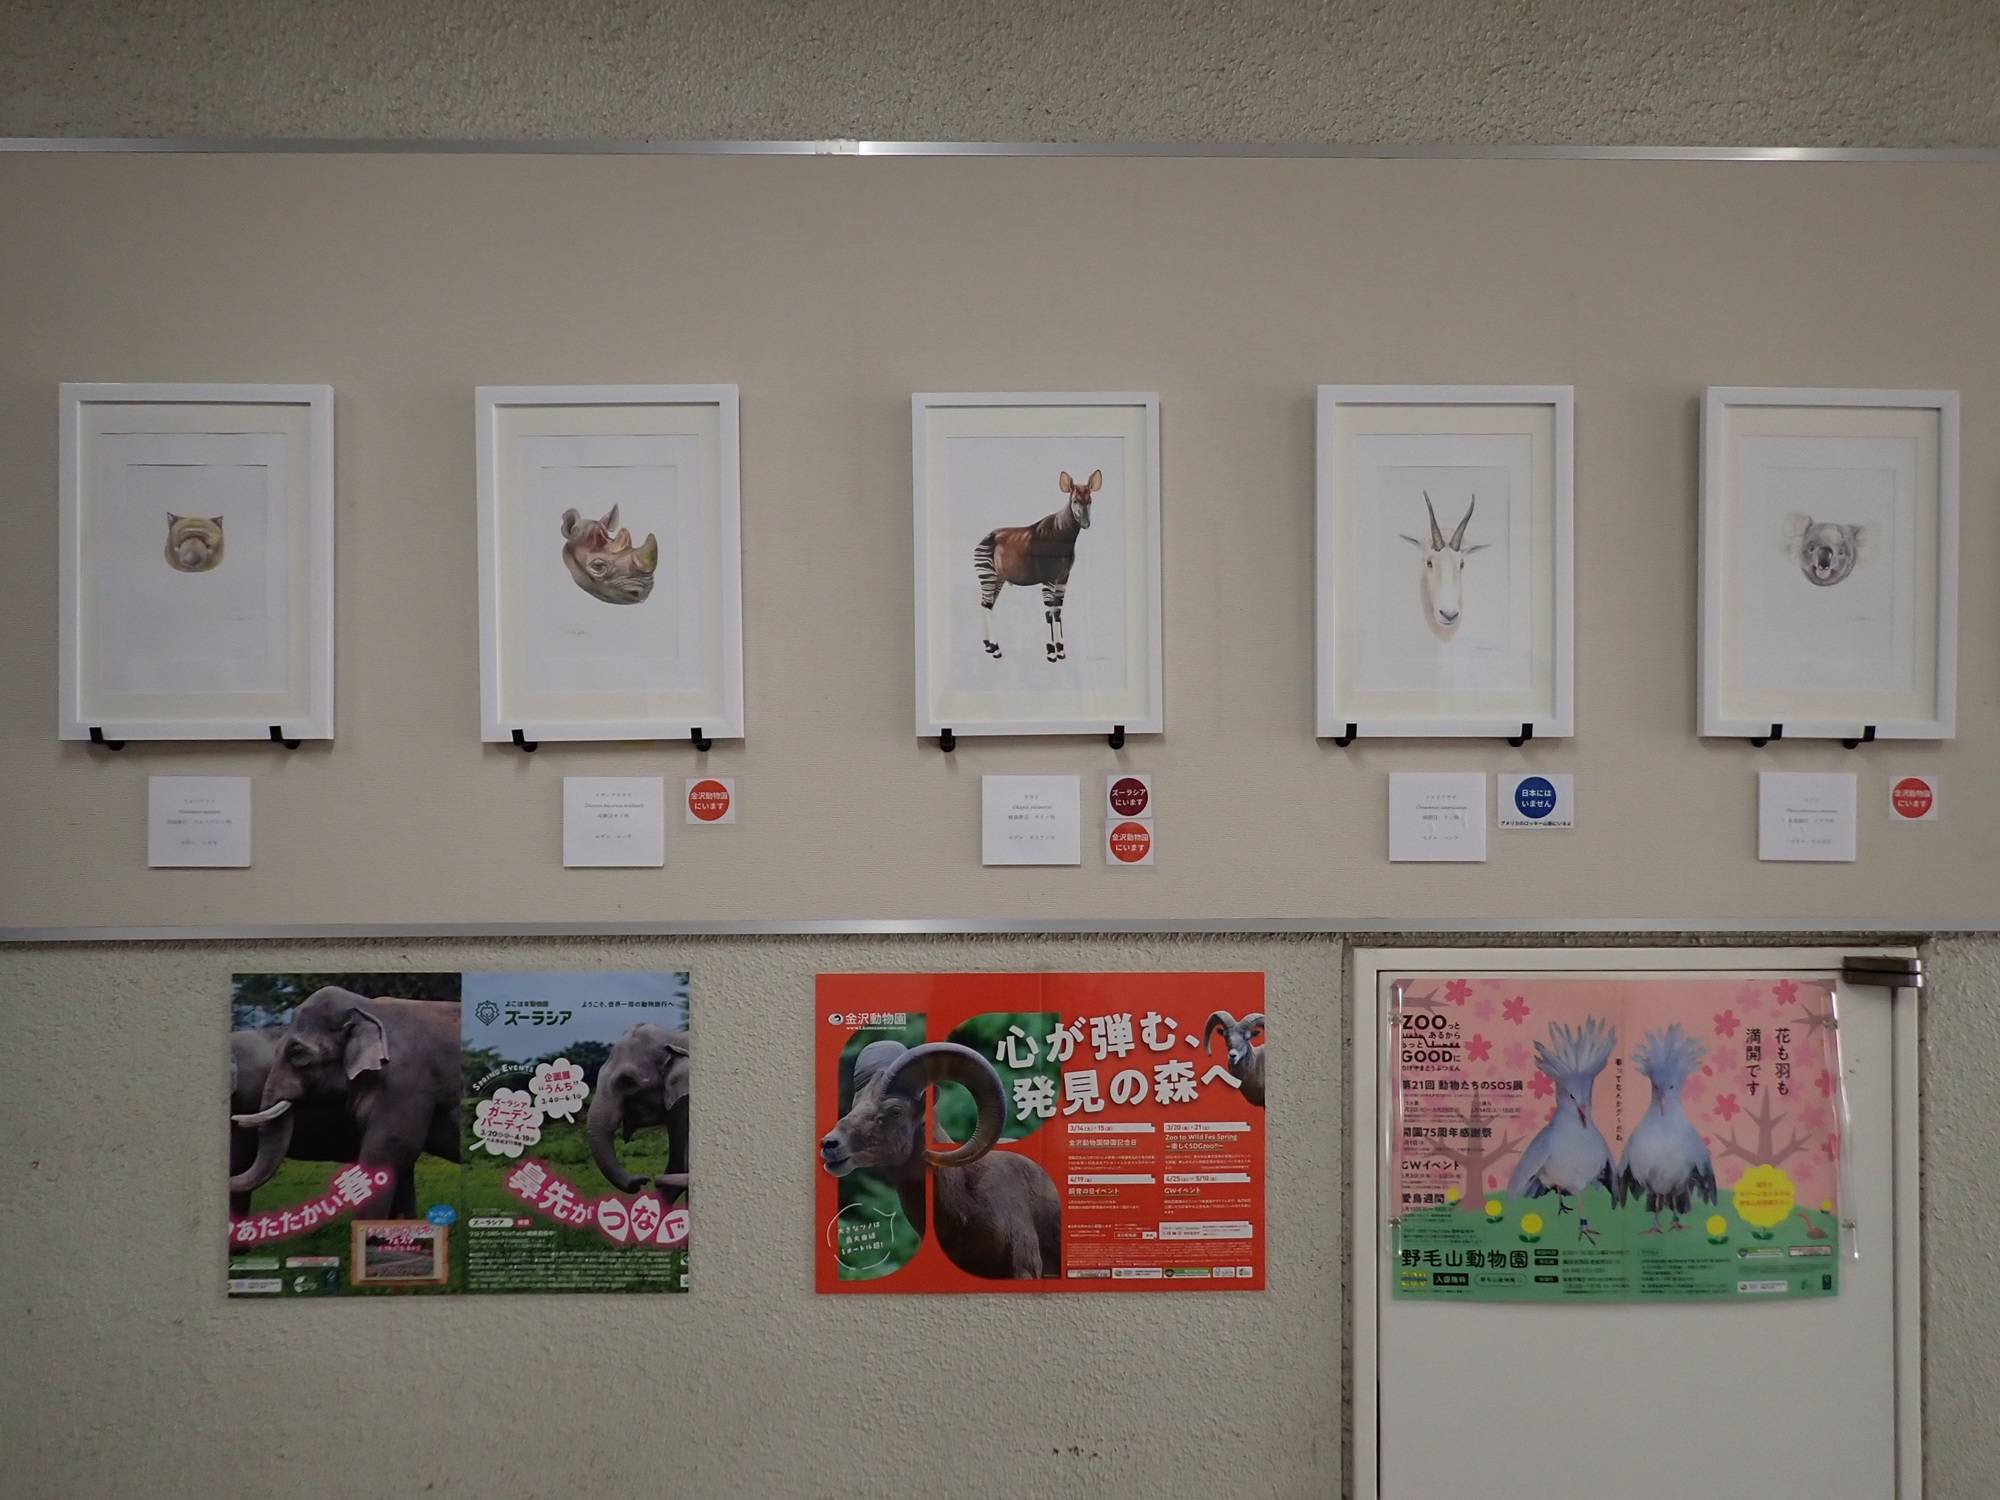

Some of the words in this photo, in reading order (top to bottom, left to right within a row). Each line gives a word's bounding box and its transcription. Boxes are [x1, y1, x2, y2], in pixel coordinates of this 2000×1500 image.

[691, 791, 728, 800] 金沢動物園
[1112, 788, 1146, 796] ズーラシア
[1522, 789, 1552, 797] 日本には
[695, 802, 724, 811] にいます
[1115, 798, 1143, 806] にいます
[1521, 800, 1552, 808] いません
[1112, 833, 1149, 842] 金沢動物園
[1115, 844, 1145, 852] にいます
[504, 1010, 572, 1026] ズーラシア
[845, 1012, 907, 1025] 金沢動物園
[1402, 1014, 1461, 1030] ZOOっと
[995, 1011, 1200, 1070] 心が弾む、
[1428, 1031, 1461, 1039] あるから
[1402, 1040, 1423, 1049] もっと
[1402, 1050, 1461, 1063] GOODに
[1745, 1027, 1761, 1096] 満開です
[544, 1071, 571, 1083] 企画展
[1012, 1059, 1242, 1121] 発見の森へ
[1403, 1079, 1435, 1090] 第21回
[1438, 1079, 1523, 1091] 動物たちのSOS展
[493, 1097, 528, 1109] ズーラシア
[488, 1106, 533, 1121] ガーデン
[481, 1117, 537, 1131] パーティー
[1402, 1160, 1459, 1171] GWイベント
[1164, 1186, 1200, 1194] GWイベント
[237, 1165, 389, 1242] あたたかい春。
[1401, 1249, 1528, 1269] 野毛山動物園
